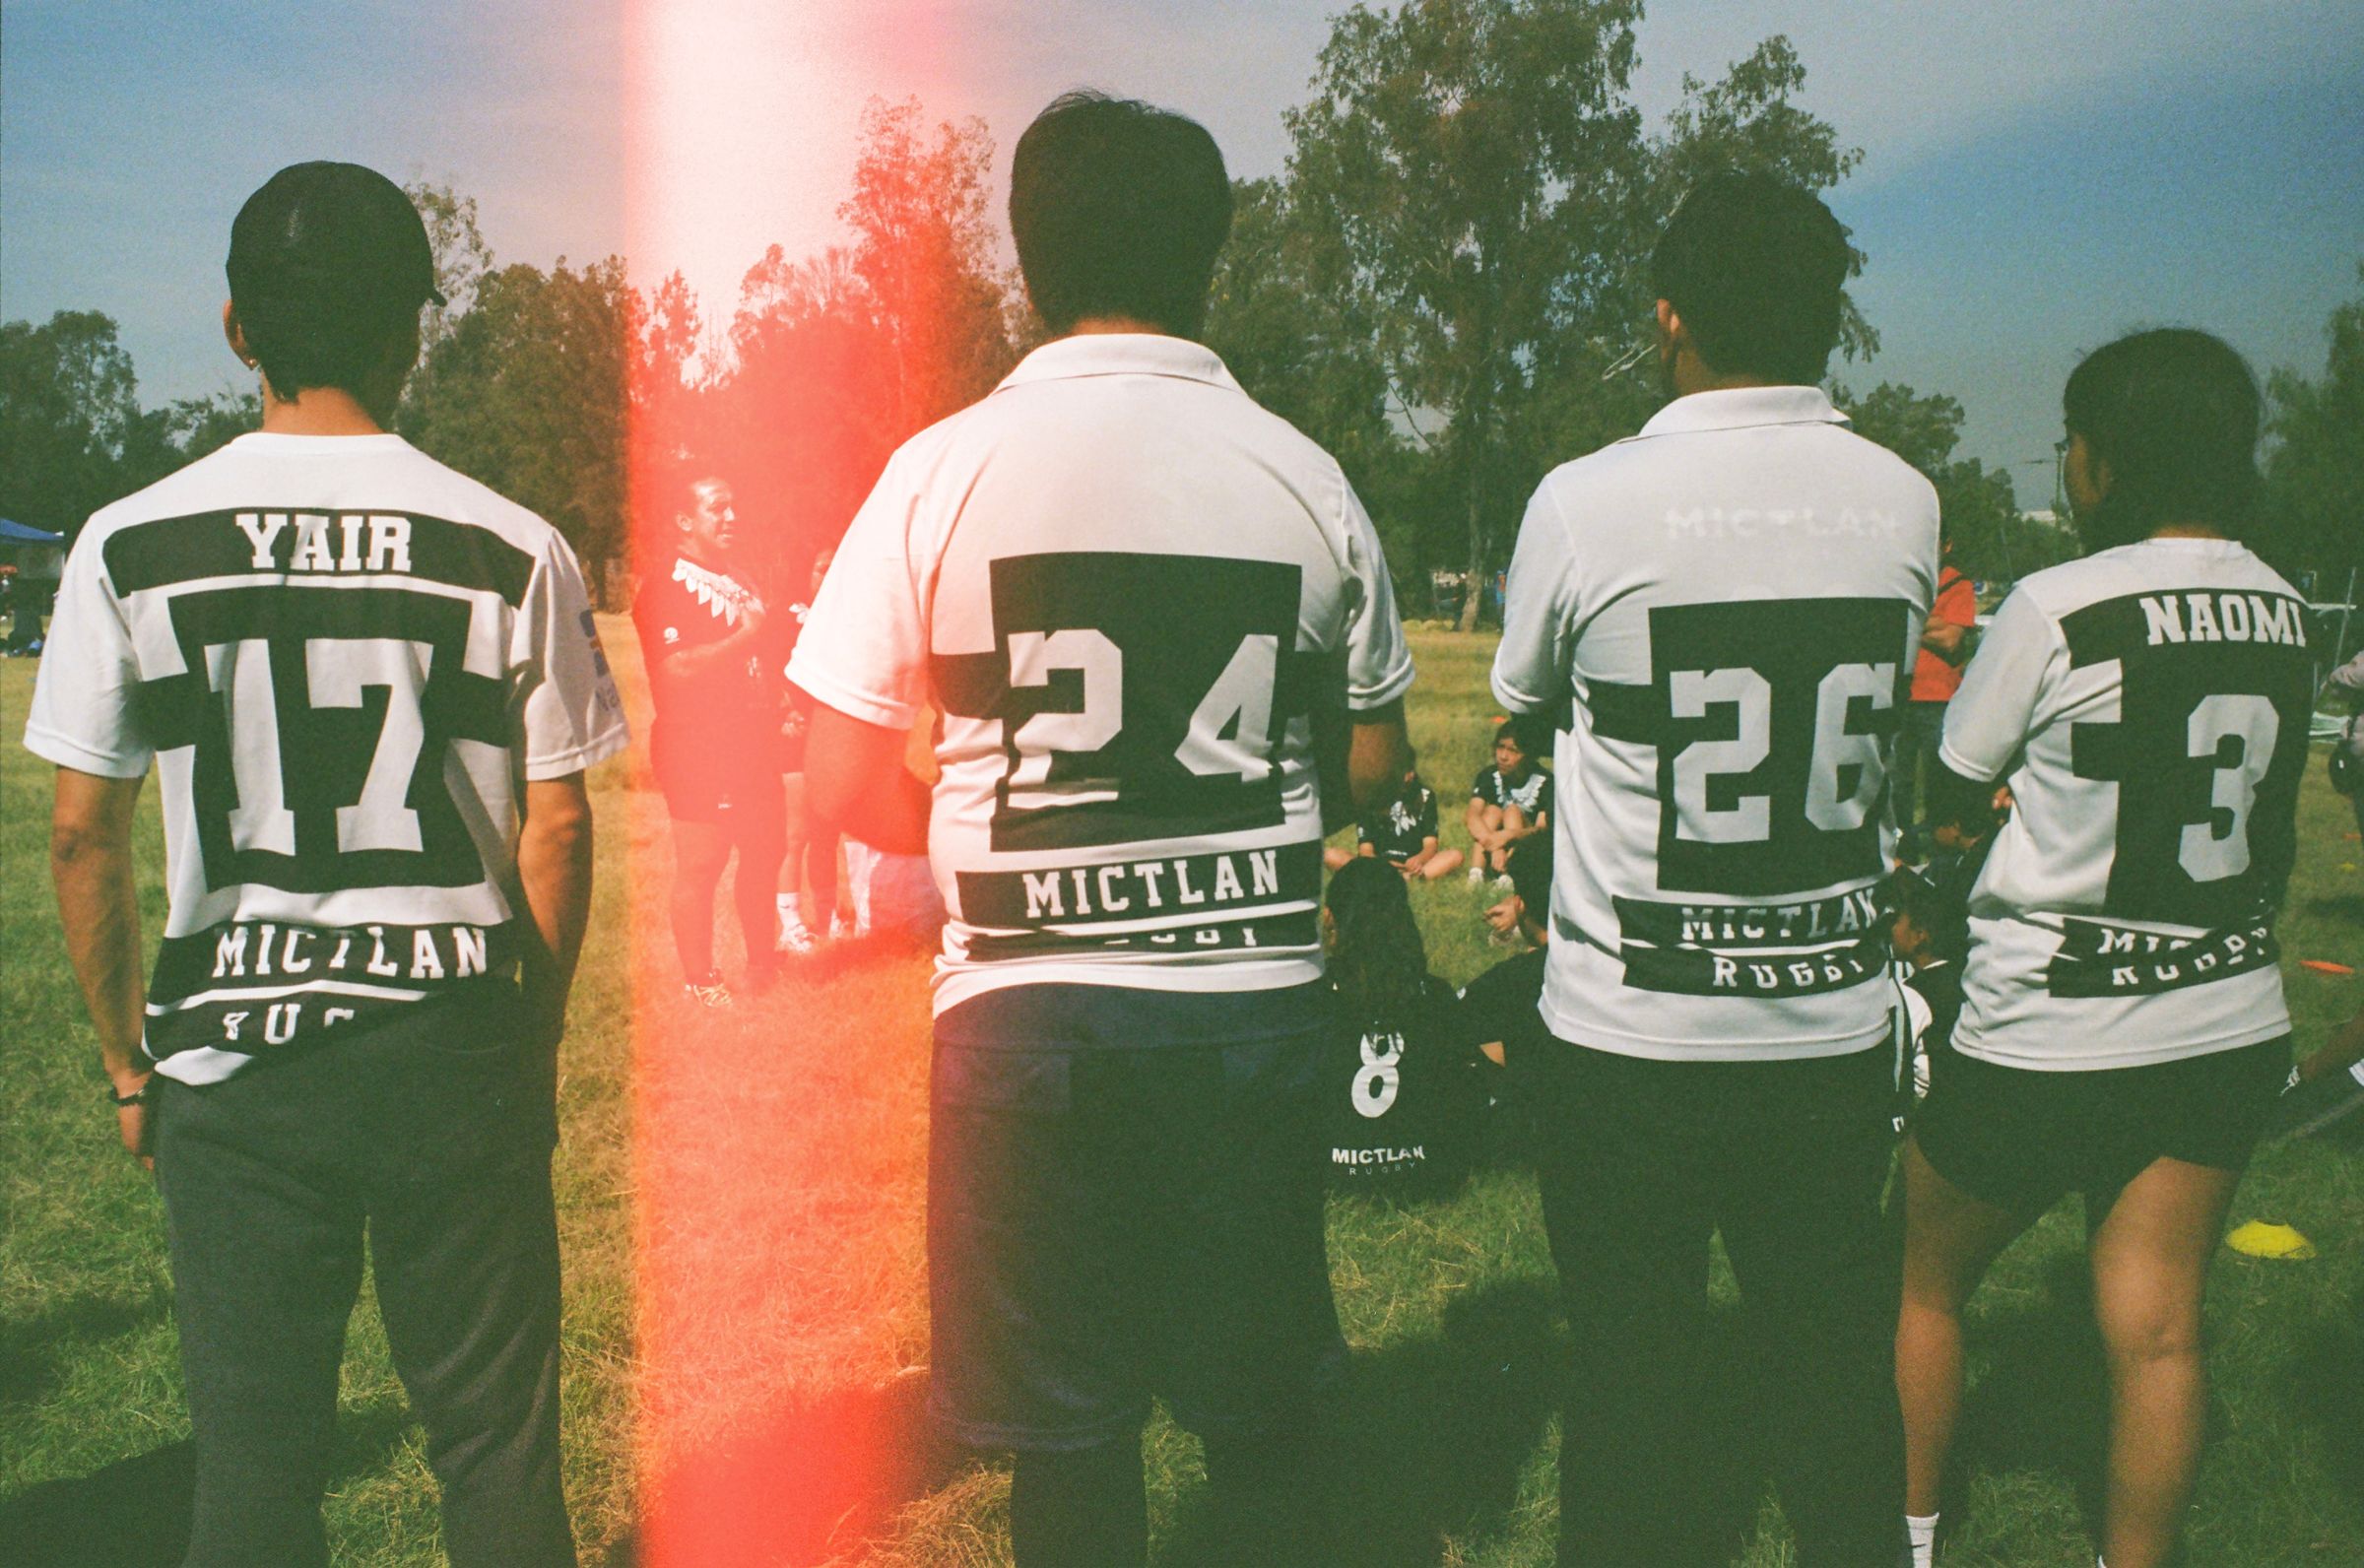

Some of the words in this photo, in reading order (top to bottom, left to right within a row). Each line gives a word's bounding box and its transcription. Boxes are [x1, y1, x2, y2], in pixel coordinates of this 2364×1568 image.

[235, 513, 412, 572] YAIR
[2138, 593, 2307, 647] NAOMI
[204, 637, 433, 856] 17
[1007, 627, 1279, 810] 24
[1670, 662, 1896, 843] 26
[2177, 693, 2279, 882] 3
[1021, 849, 1279, 919] MICTLAN
[1680, 887, 1877, 942] MICTLAN
[211, 924, 488, 979] MICTLAN
[1332, 1144, 1425, 1165] MICTLAN
[1348, 1161, 1415, 1176] RUGBY
